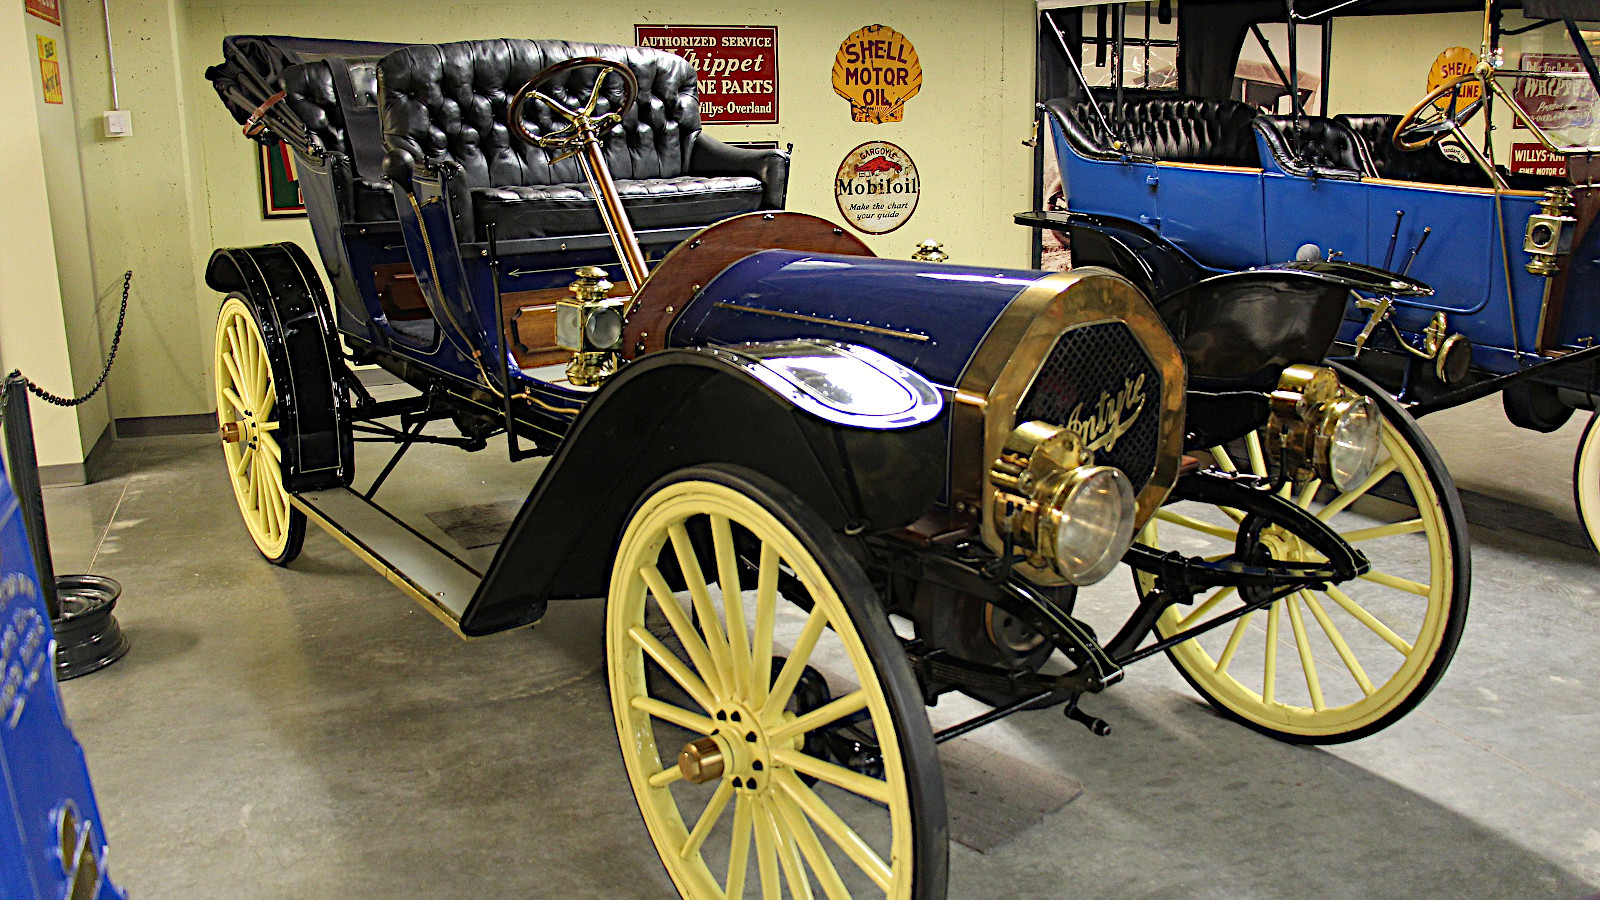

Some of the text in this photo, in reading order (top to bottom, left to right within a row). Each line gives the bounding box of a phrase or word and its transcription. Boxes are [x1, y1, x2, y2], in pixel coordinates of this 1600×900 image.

[641, 36, 772, 47] AUTHORIZED SERVICE
[845, 39, 908, 64] SHELL
[845, 67, 909, 86] MOTOR
[696, 80, 773, 94] NE PARTS
[862, 88, 893, 106] OIL
[699, 101, 772, 117] illys-Overland
[1536, 167, 1557, 176] MOTOR
[838, 177, 917, 195] Mobiloil
[849, 201, 908, 211] Make the chart
[856, 210, 900, 221] your guide
